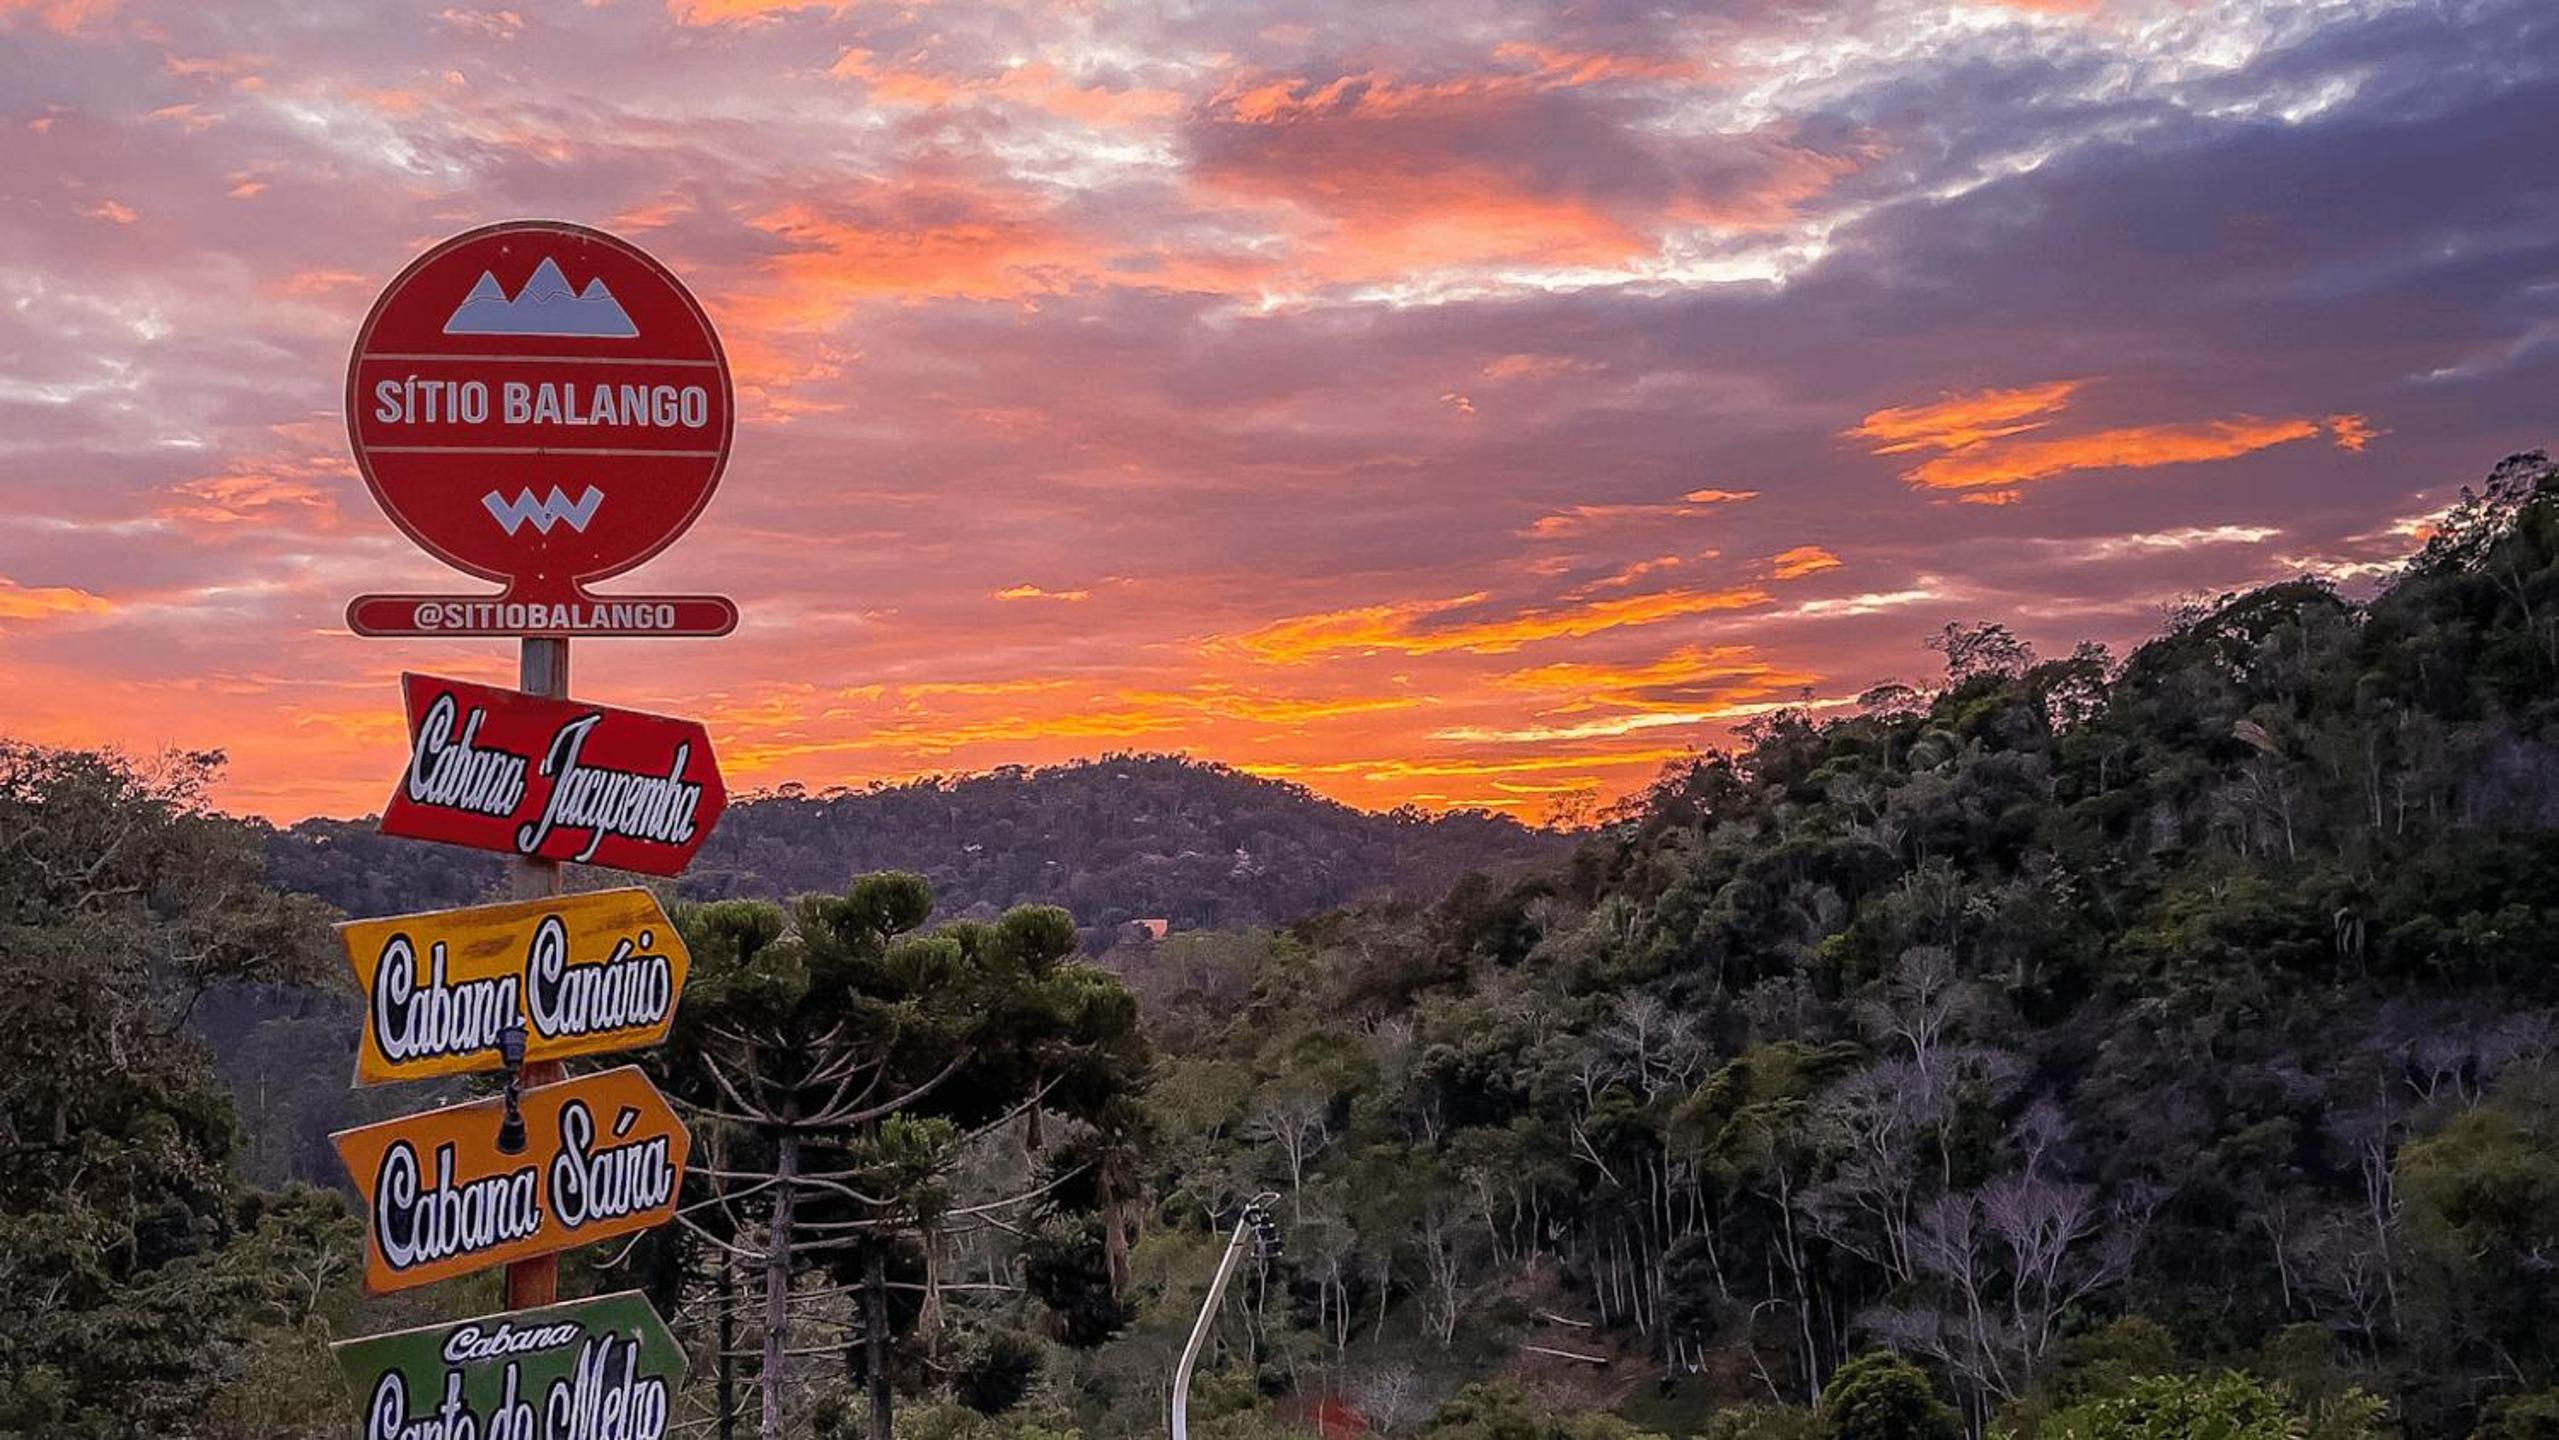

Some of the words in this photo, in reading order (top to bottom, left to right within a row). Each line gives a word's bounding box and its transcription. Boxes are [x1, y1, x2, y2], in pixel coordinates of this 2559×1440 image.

[375, 375, 489, 425] SÍTIO
[503, 381, 708, 428] BALANGO
[413, 603, 676, 630] @SITIOBALANGO
[409, 694, 526, 816] Cabana
[377, 938, 526, 1059] Cabana
[528, 918, 669, 1036] Canário
[379, 1145, 541, 1267] Cabana
[553, 1104, 673, 1227] Saíra
[444, 1323, 580, 1361] Cabana
